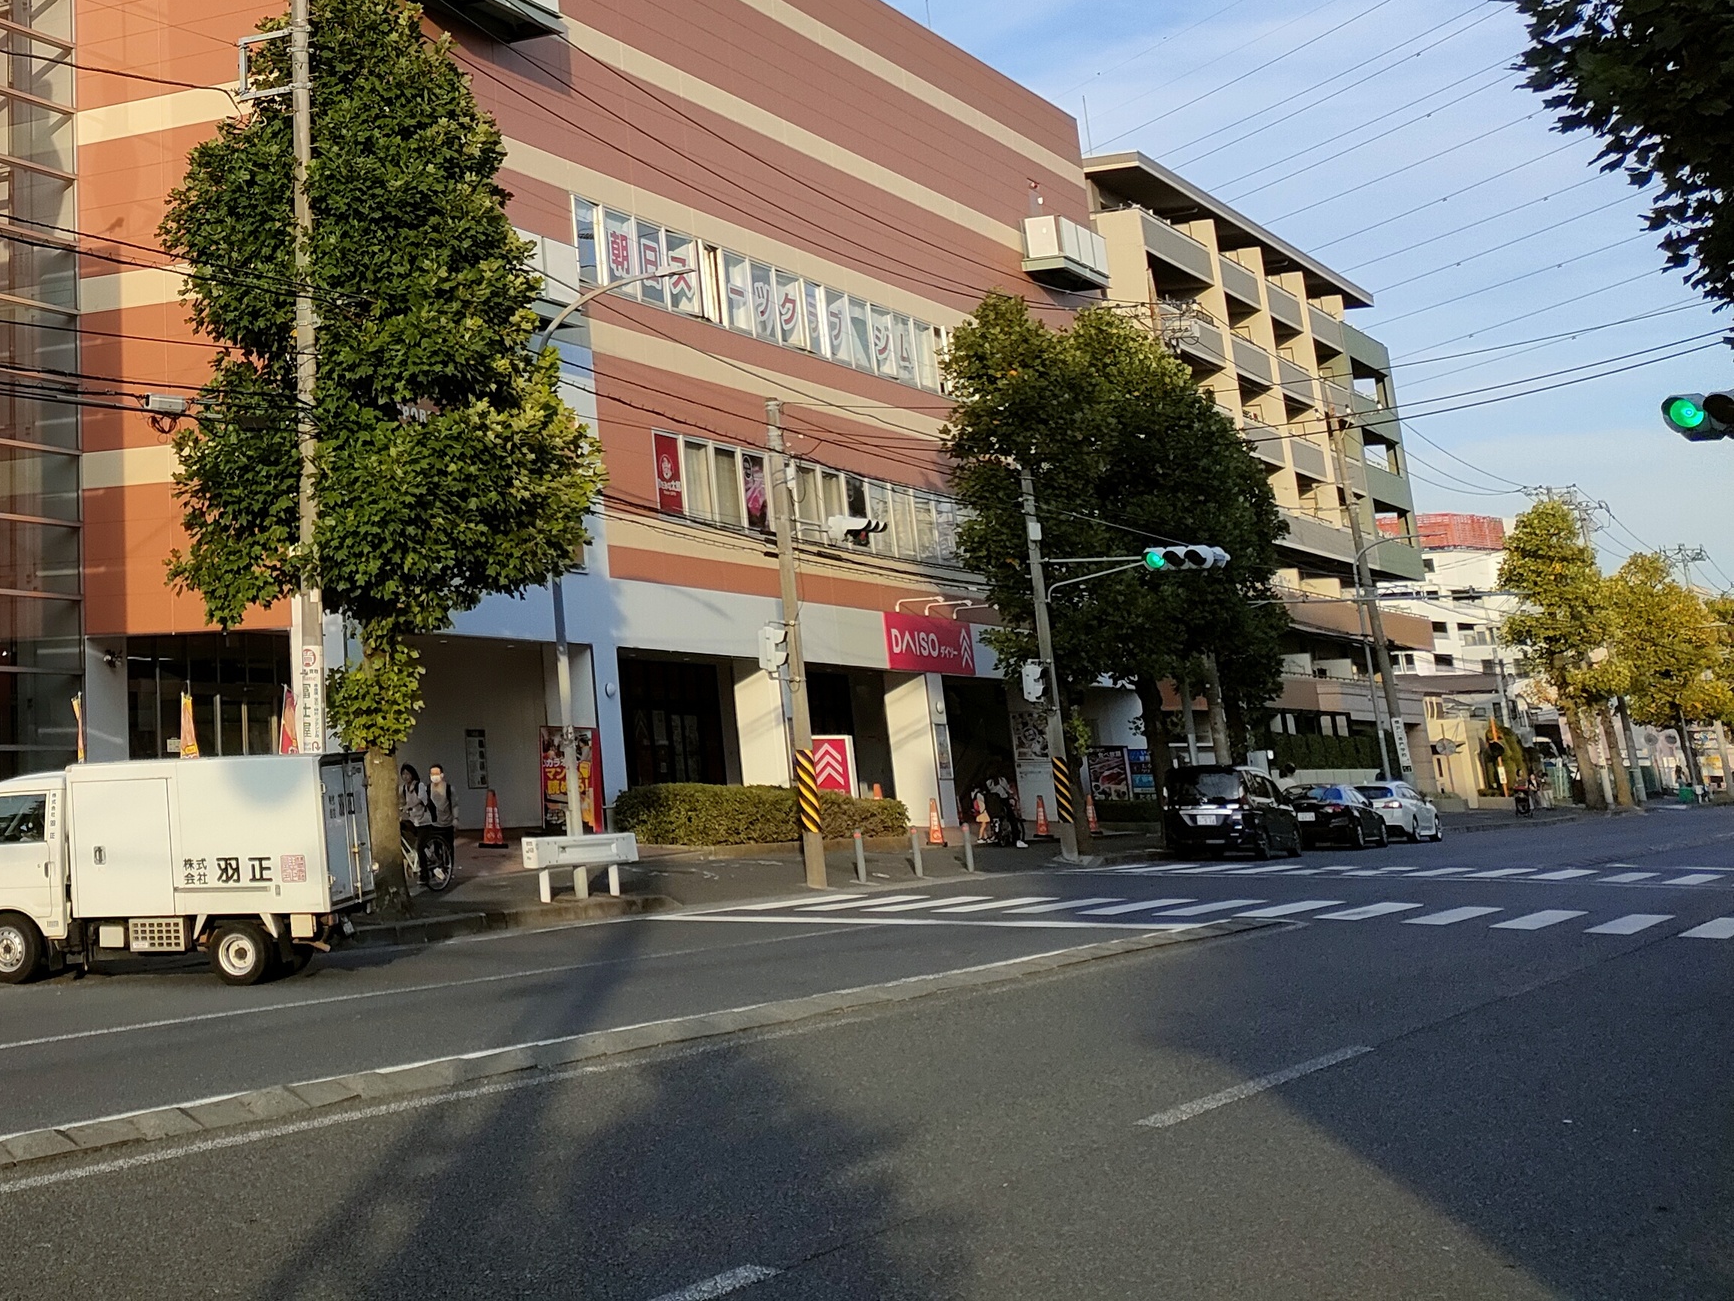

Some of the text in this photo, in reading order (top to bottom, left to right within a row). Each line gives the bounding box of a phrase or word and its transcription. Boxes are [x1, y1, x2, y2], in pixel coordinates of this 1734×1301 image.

[890, 628, 939, 658] DAISO
[940, 644, 958, 660] ダイソー
[182, 858, 208, 871] 株式
[215, 857, 274, 884] 羽正
[183, 872, 209, 885] 会社
